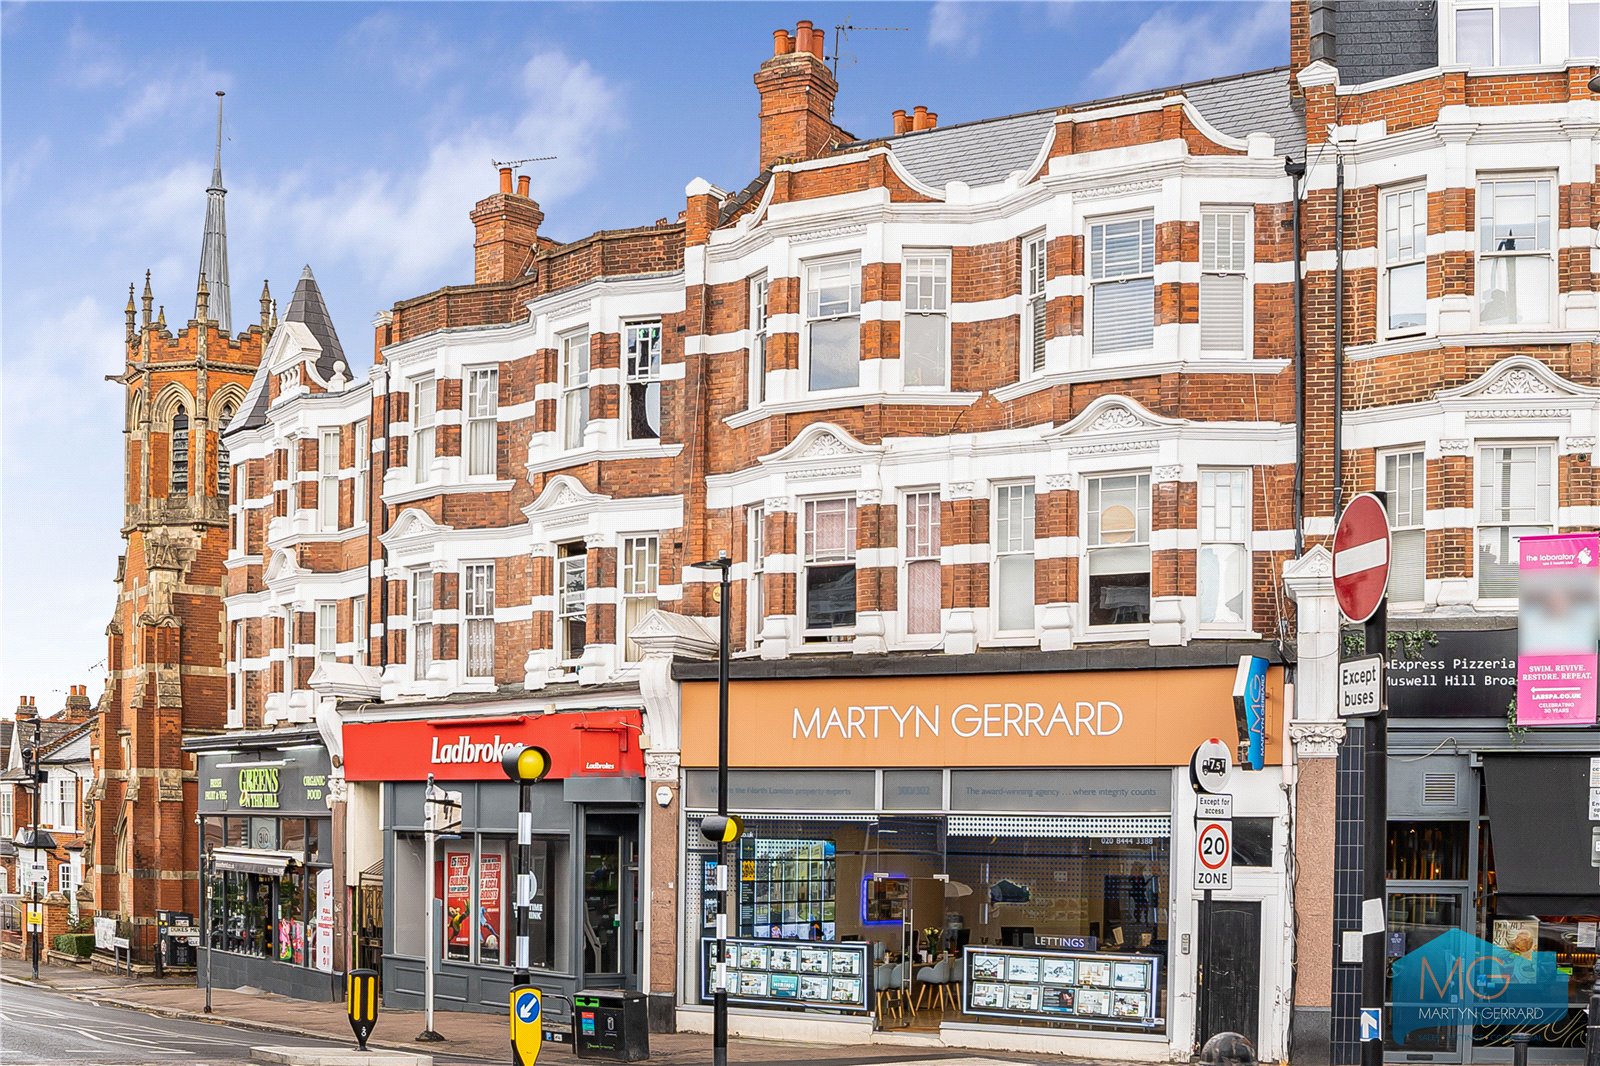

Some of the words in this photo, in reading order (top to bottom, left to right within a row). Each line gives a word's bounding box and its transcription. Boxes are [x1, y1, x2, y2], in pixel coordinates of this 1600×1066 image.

[1540, 553, 1575, 561] laboratory
[1453, 659, 1516, 670] Pizzeria
[1342, 666, 1376, 686] Except
[1445, 675, 1476, 686] Hill
[1485, 675, 1518, 686] Broa
[1561, 672, 1592, 680] REPEAT.
[1249, 674, 1261, 733] MG
[1345, 691, 1374, 707] buses
[792, 704, 940, 739] MARTYN
[951, 701, 1124, 738] GERRARD
[431, 735, 524, 764] Ladbrok
[586, 762, 615, 770] Ladbrokes
[239, 768, 279, 792] GREENS
[303, 776, 326, 786] ORGANIC
[307, 790, 321, 800] FOOD
[769, 787, 793, 795] London
[795, 788, 824, 797] property
[825, 788, 851, 797] experts
[966, 786, 980, 796] The
[981, 787, 1033, 797] award-winning
[1035, 788, 1060, 798] agency
[1073, 787, 1097, 797] where
[1099, 787, 1129, 798] integrity
[1131, 787, 1157, 797] counts
[252, 793, 264, 808] THE
[264, 793, 280, 808] HILL
[1200, 797, 1220, 806] Except
[1221, 797, 1230, 806] for
[1205, 807, 1225, 815] access
[1101, 837, 1113, 845] 020
[1116, 837, 1133, 845] 8444
[1203, 836, 1225, 855] 20
[1198, 873, 1228, 884] ZONE
[1034, 936, 1085, 948] LETTINGS
